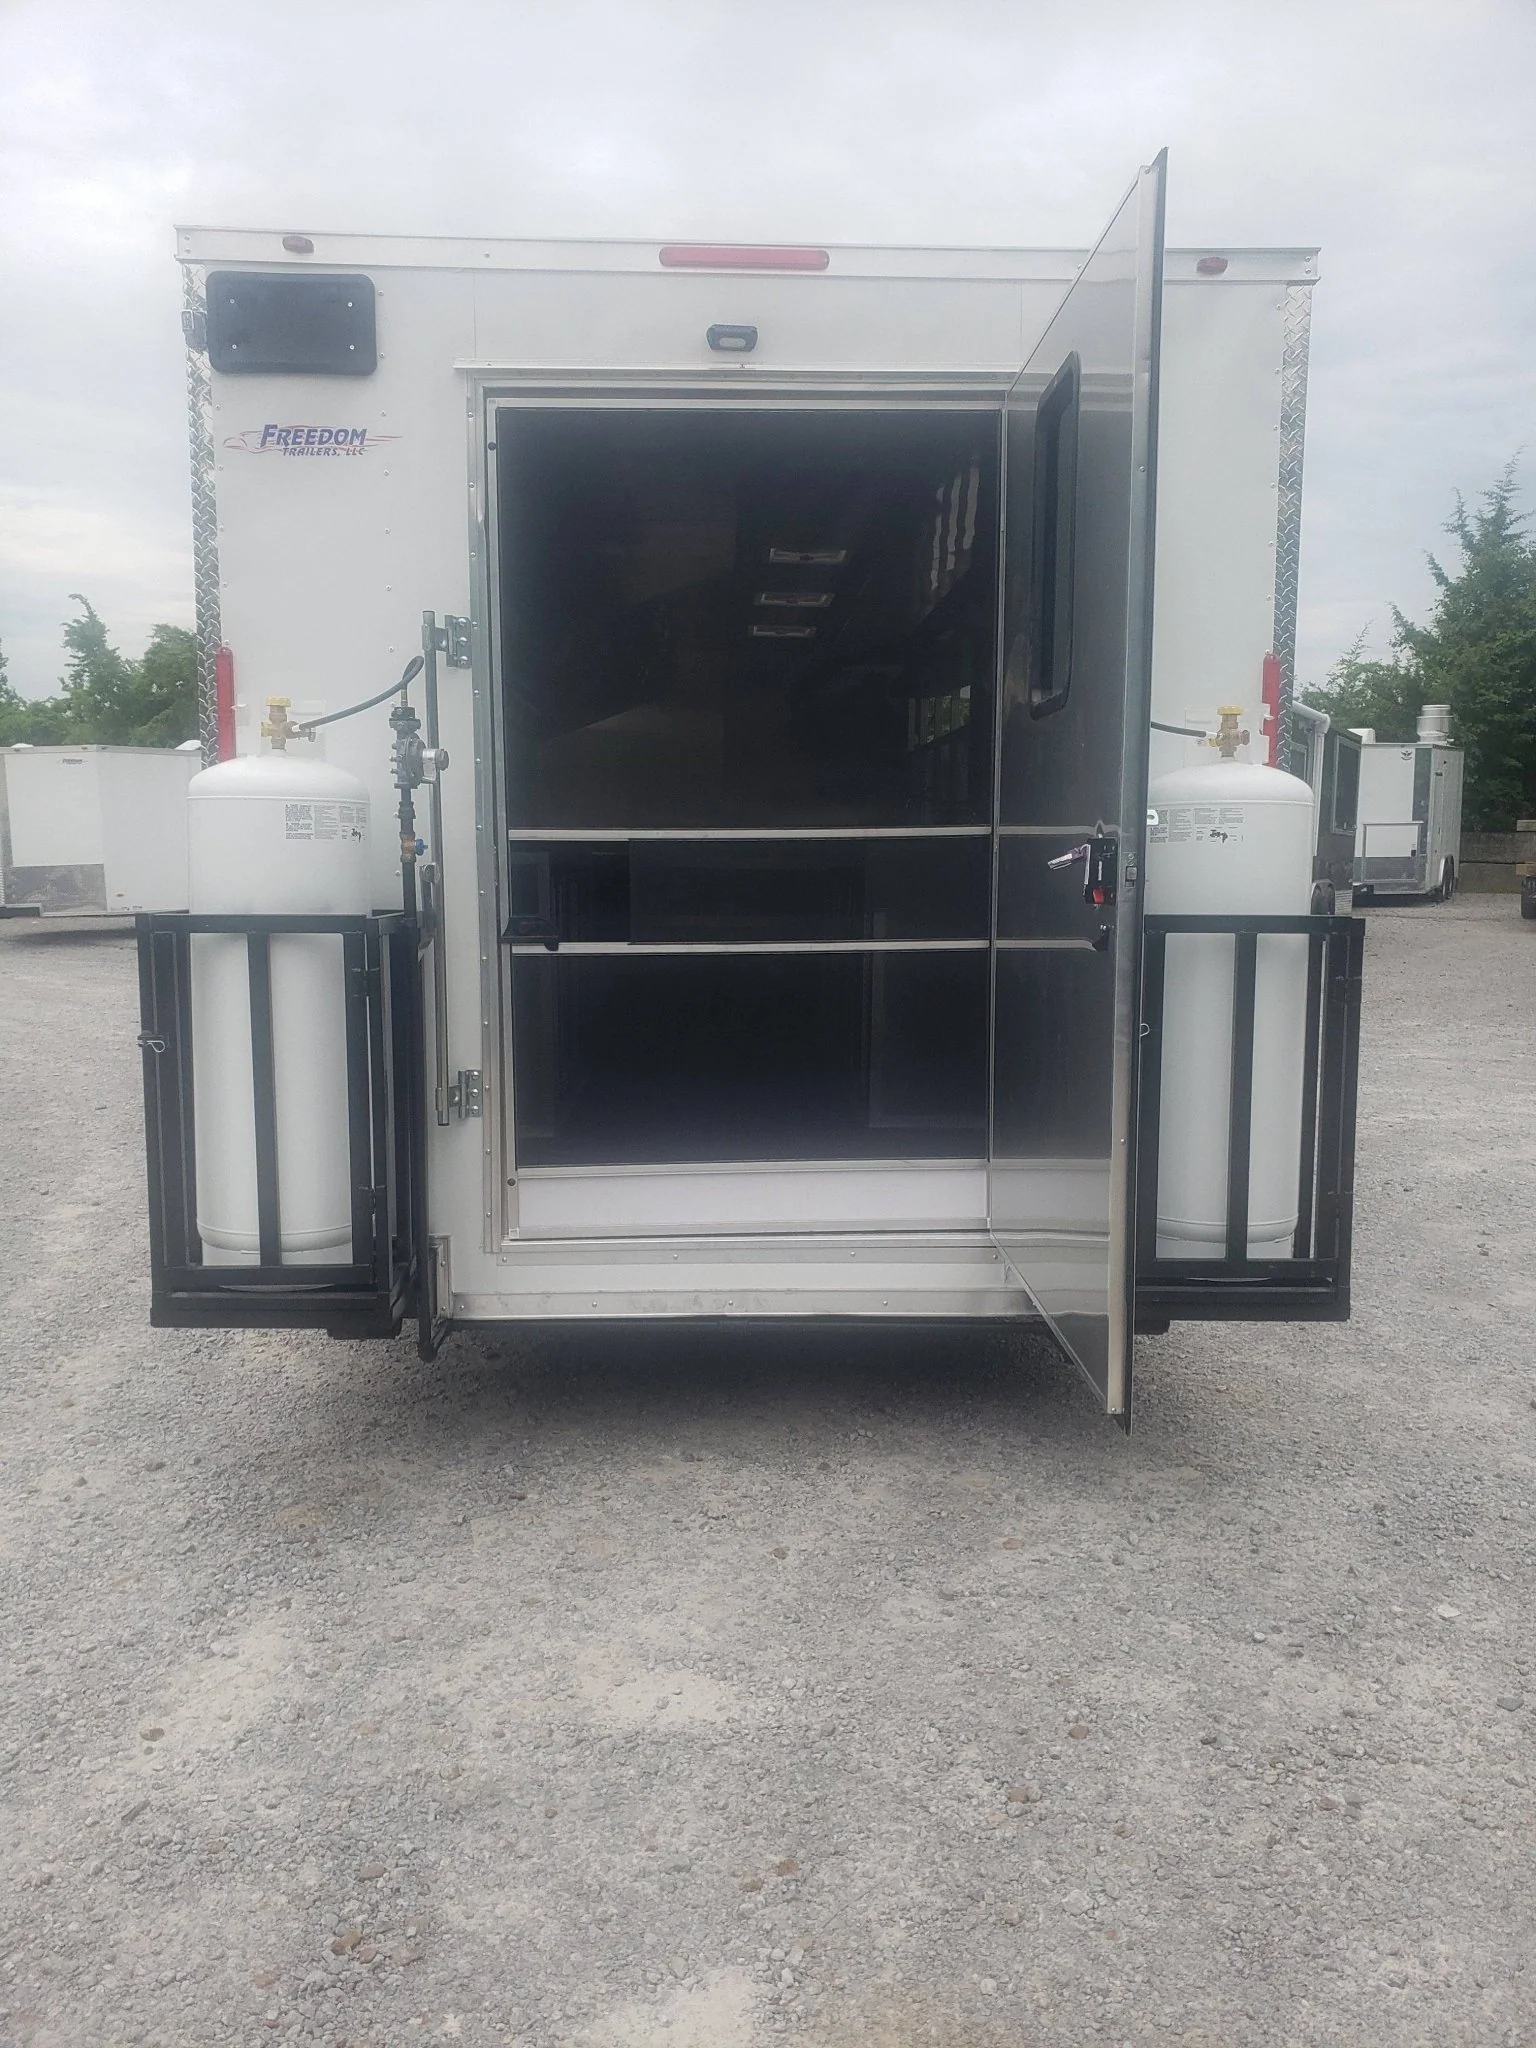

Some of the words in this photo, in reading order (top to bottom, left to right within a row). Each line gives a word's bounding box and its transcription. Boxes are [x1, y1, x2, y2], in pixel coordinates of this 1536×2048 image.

[260, 424, 367, 447] FREEDOM
[282, 447, 340, 457] TRAILERS,
[345, 447, 365, 456] LLC
